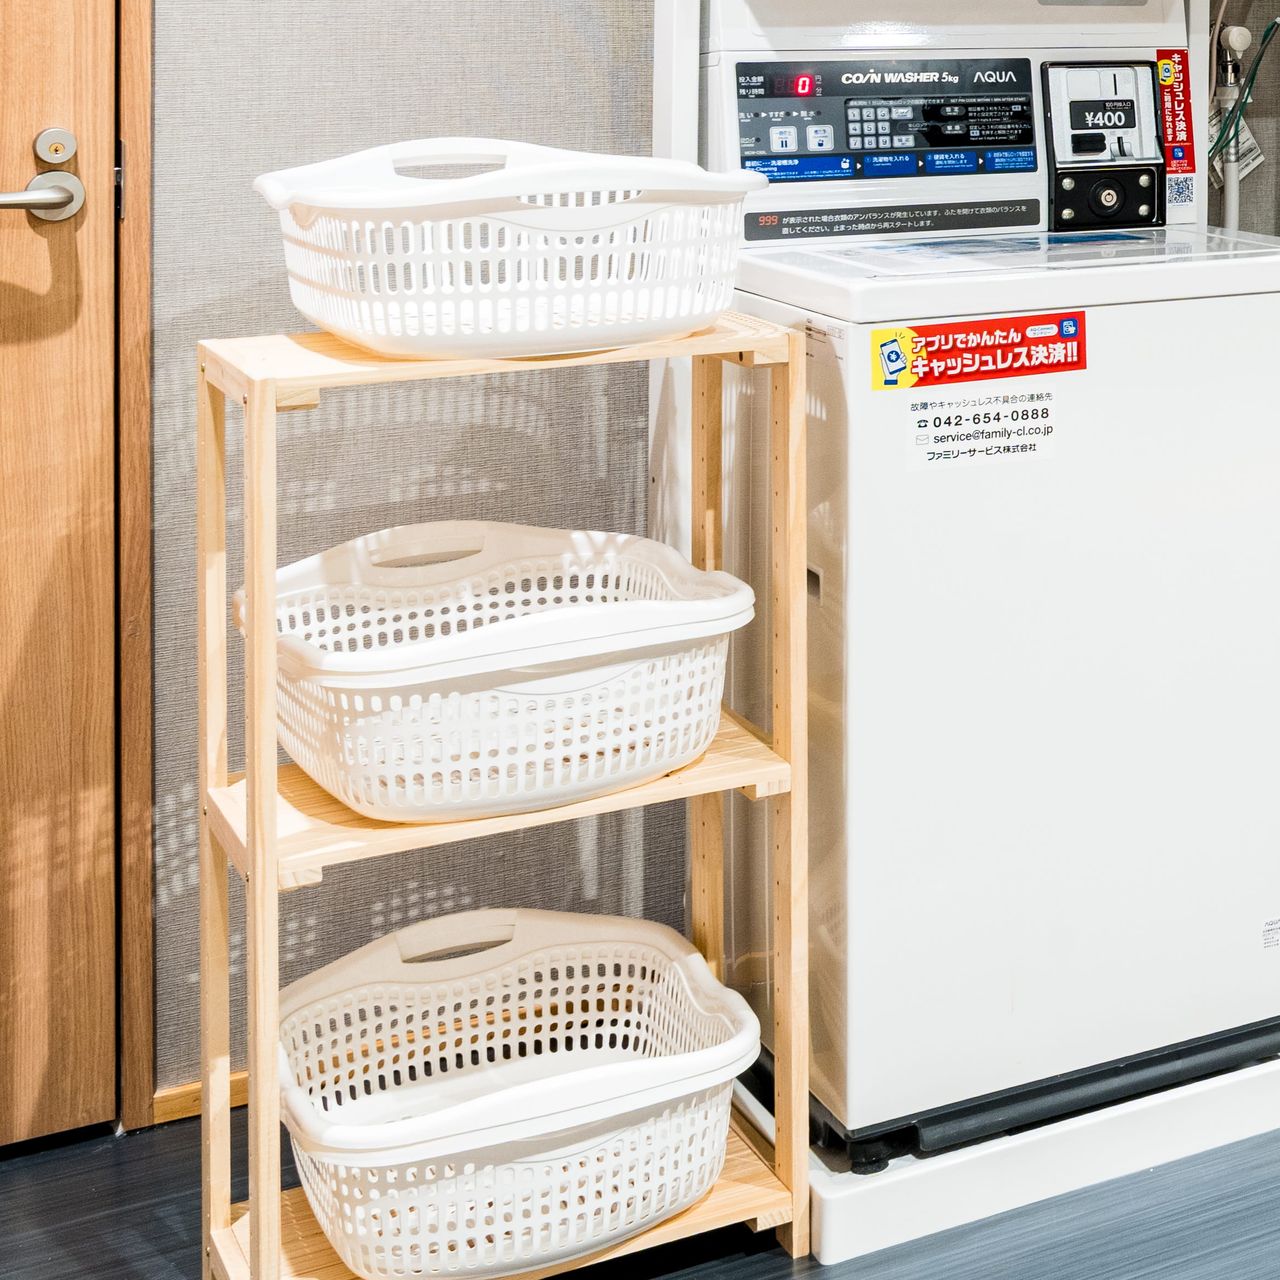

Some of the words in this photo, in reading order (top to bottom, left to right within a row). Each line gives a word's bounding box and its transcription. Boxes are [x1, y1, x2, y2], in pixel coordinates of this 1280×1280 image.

[798, 77, 810, 93] 0
[885, 72, 939, 83] WASHER
[941, 73, 959, 83] 5kg
[974, 71, 1016, 83] AQUA
[1171, 53, 1187, 142] キャッシュレス決済
[1085, 111, 1125, 127] ¥400
[1164, 89, 1173, 142] ご利用になれます
[758, 216, 778, 225] 999
[912, 329, 1021, 353] アプリでかんたん
[911, 392, 1053, 412] 故障やキャッシュレス不具合の連絡先
[933, 408, 1050, 428] 042-654-0888
[934, 424, 1054, 444] service@family-cl.co.jp
[927, 443, 1037, 461] ファミリーサービス株式会社
